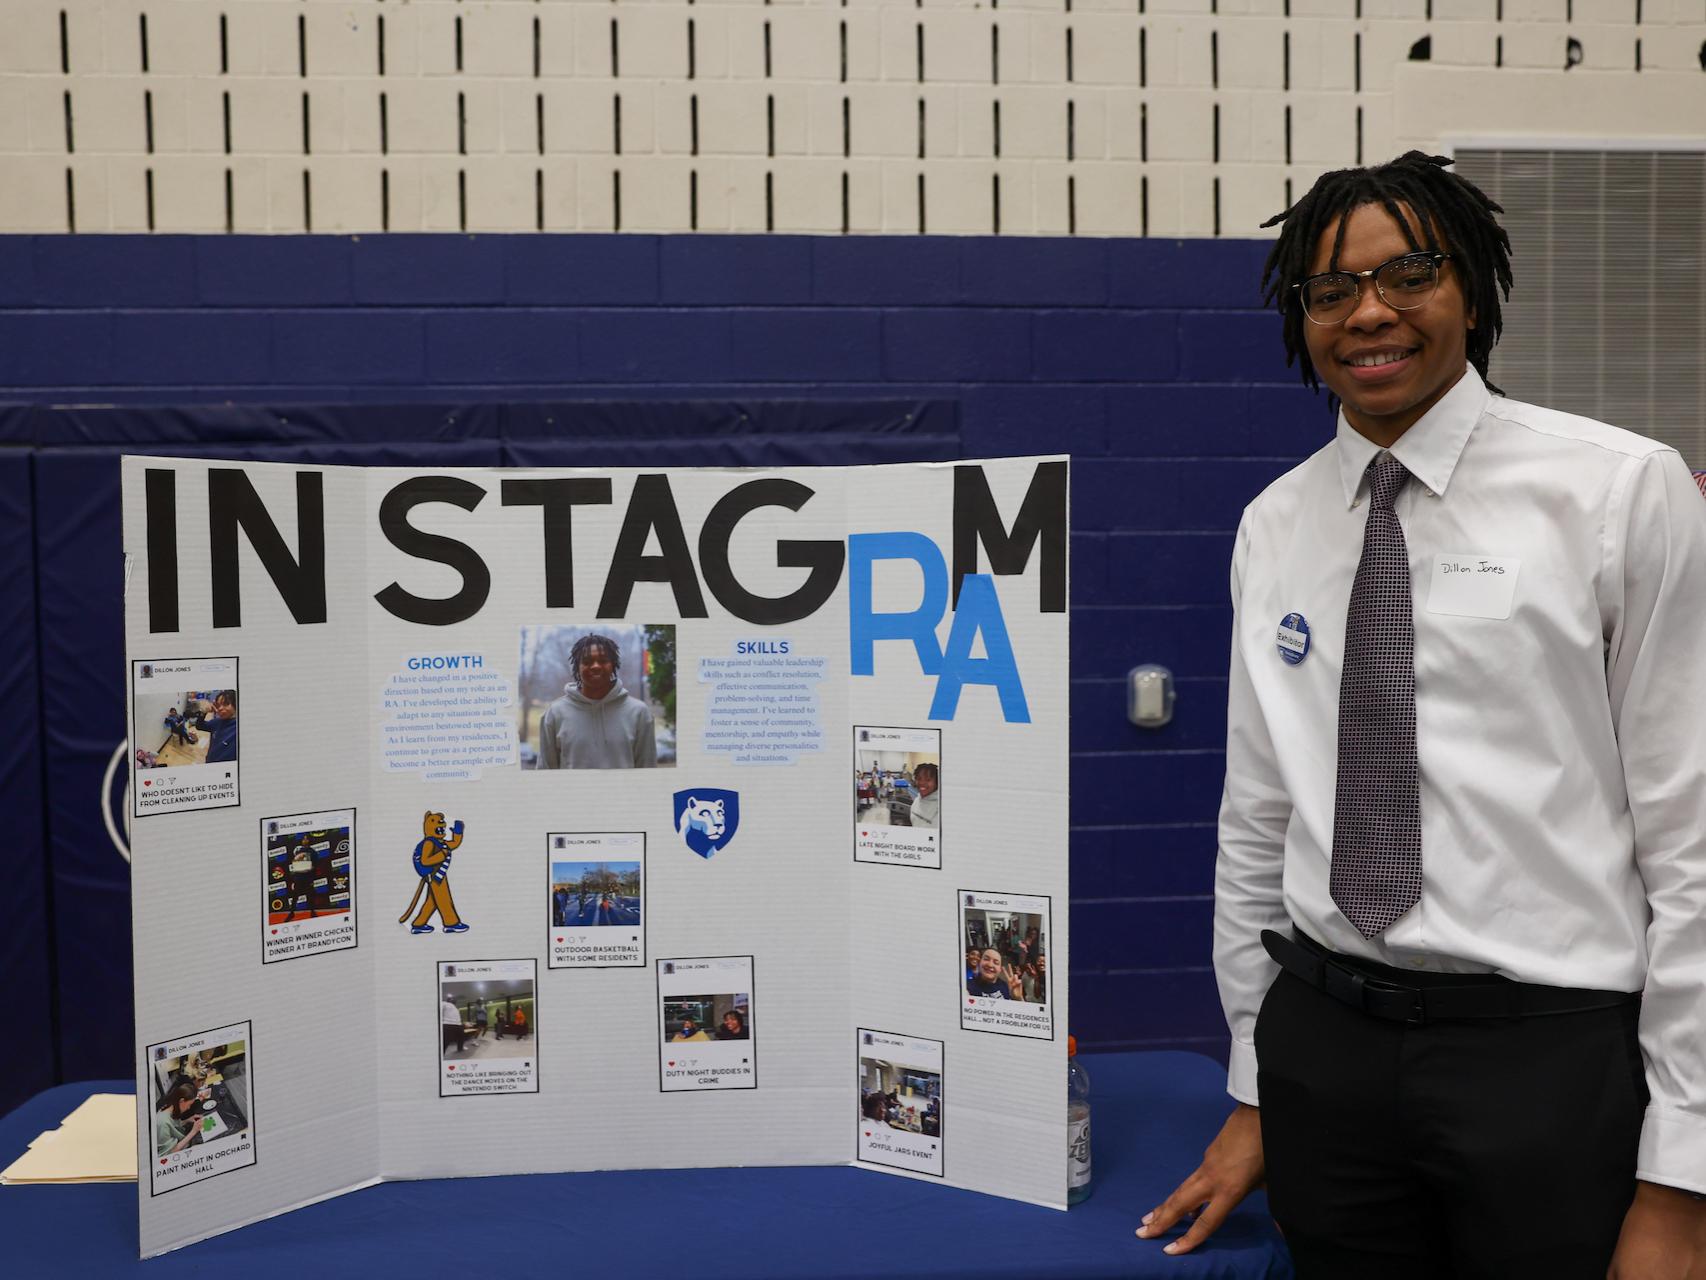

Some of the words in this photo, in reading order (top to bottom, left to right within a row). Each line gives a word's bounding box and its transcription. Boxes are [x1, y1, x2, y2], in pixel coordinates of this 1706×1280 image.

[1441, 563, 1471, 574] Dillon
[1477, 560, 1505, 574] Jones
[737, 641, 790, 654] SKILLS
[1278, 632, 1304, 649] Exhibitor
[408, 655, 483, 670] GROWTH
[219, 782, 234, 790] HIDE
[161, 796, 196, 805] CLEANING
[209, 791, 235, 799] EVENTS
[894, 844, 915, 852] BOARD
[266, 936, 294, 947] WINNER
[295, 931, 322, 941] WINNER
[324, 926, 354, 937] CHICKEN
[269, 945, 295, 956] DINNER
[296, 943, 306, 951] AT
[307, 935, 351, 949] BRANDYCON
[1014, 1013, 1049, 1023] RESIDENCES
[168, 1045, 187, 1053] DILLON
[188, 1040, 205, 1048] JONES
[868, 1142, 893, 1152] JOYFUL
[894, 1146, 911, 1156] JARS
[912, 1149, 933, 1159] EVENT
[156, 1165, 179, 1177] PAINT
[181, 1158, 205, 1170] NIGHT
[215, 1143, 251, 1159] ORCHARD
[195, 1164, 214, 1174] HALL
